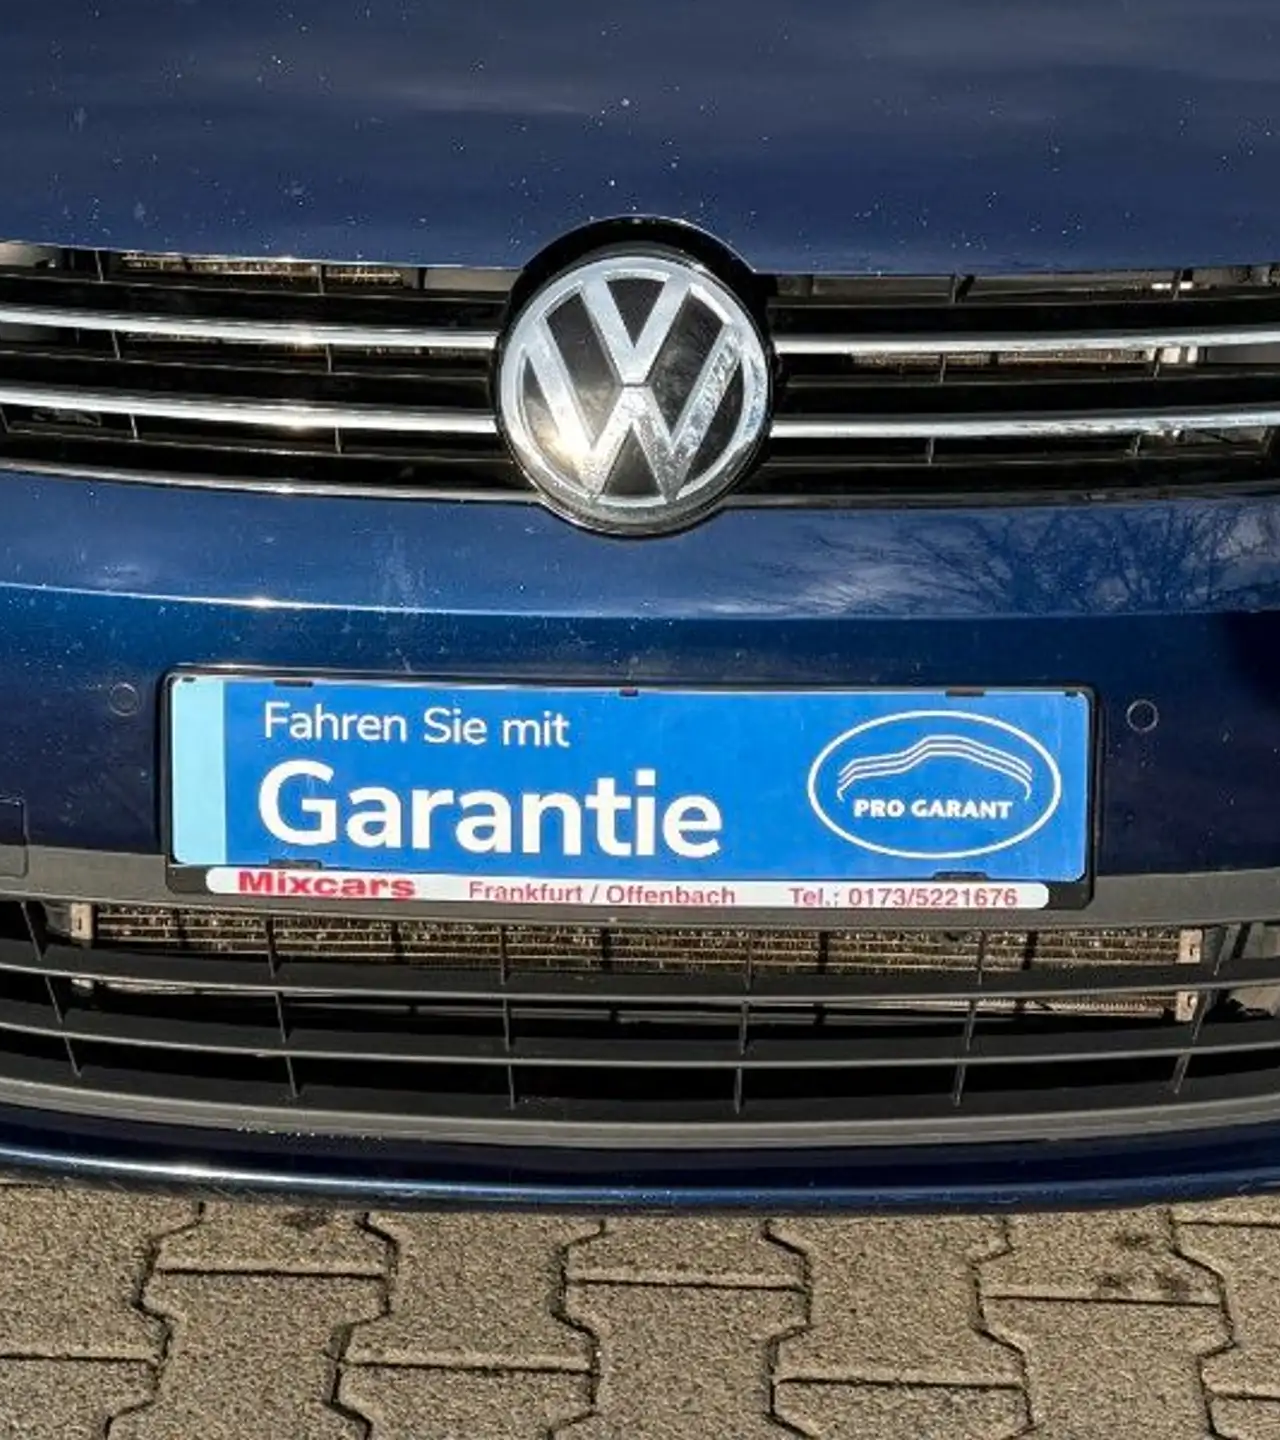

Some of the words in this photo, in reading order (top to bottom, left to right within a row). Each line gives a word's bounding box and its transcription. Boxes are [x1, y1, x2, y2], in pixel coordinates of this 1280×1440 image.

[264, 701, 407, 742] Fahren
[423, 706, 487, 746] Sie
[502, 710, 570, 748] mit
[258, 759, 722, 858] Garantie
[853, 799, 905, 819] PRO
[911, 799, 1013, 820] GARANT
[237, 870, 416, 899] Mixcars
[468, 880, 583, 904] Frankfurt
[606, 884, 736, 905] Offenbach
[788, 887, 840, 907] Tel.:
[848, 887, 1018, 907] 0173/5221676
